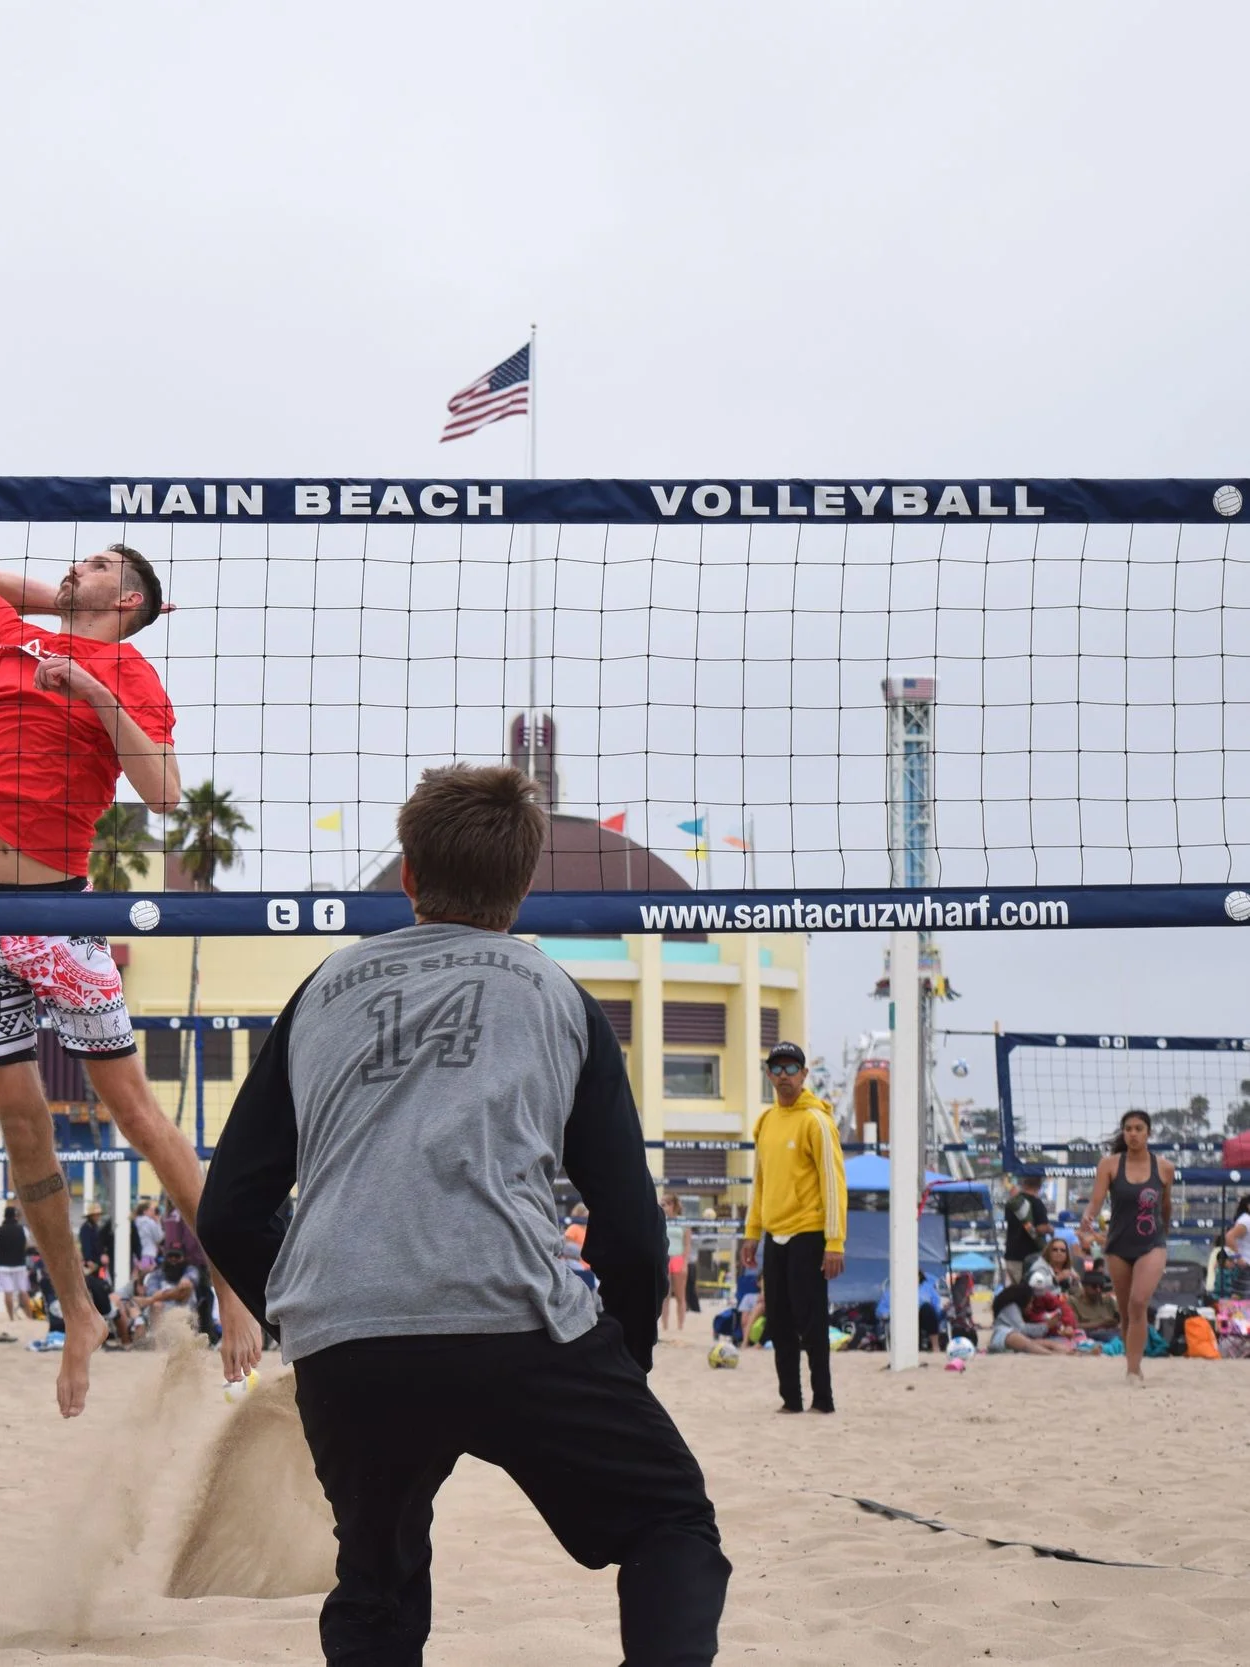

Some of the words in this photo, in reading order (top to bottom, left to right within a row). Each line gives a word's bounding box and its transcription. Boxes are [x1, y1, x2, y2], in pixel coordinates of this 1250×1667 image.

[110, 484, 263, 516] MAIN
[295, 485, 503, 517] BEACH
[650, 485, 1045, 517] VOLLEYBALL
[640, 894, 1069, 929] www.santacruzwharf.com
[361, 979, 486, 1086] 14
